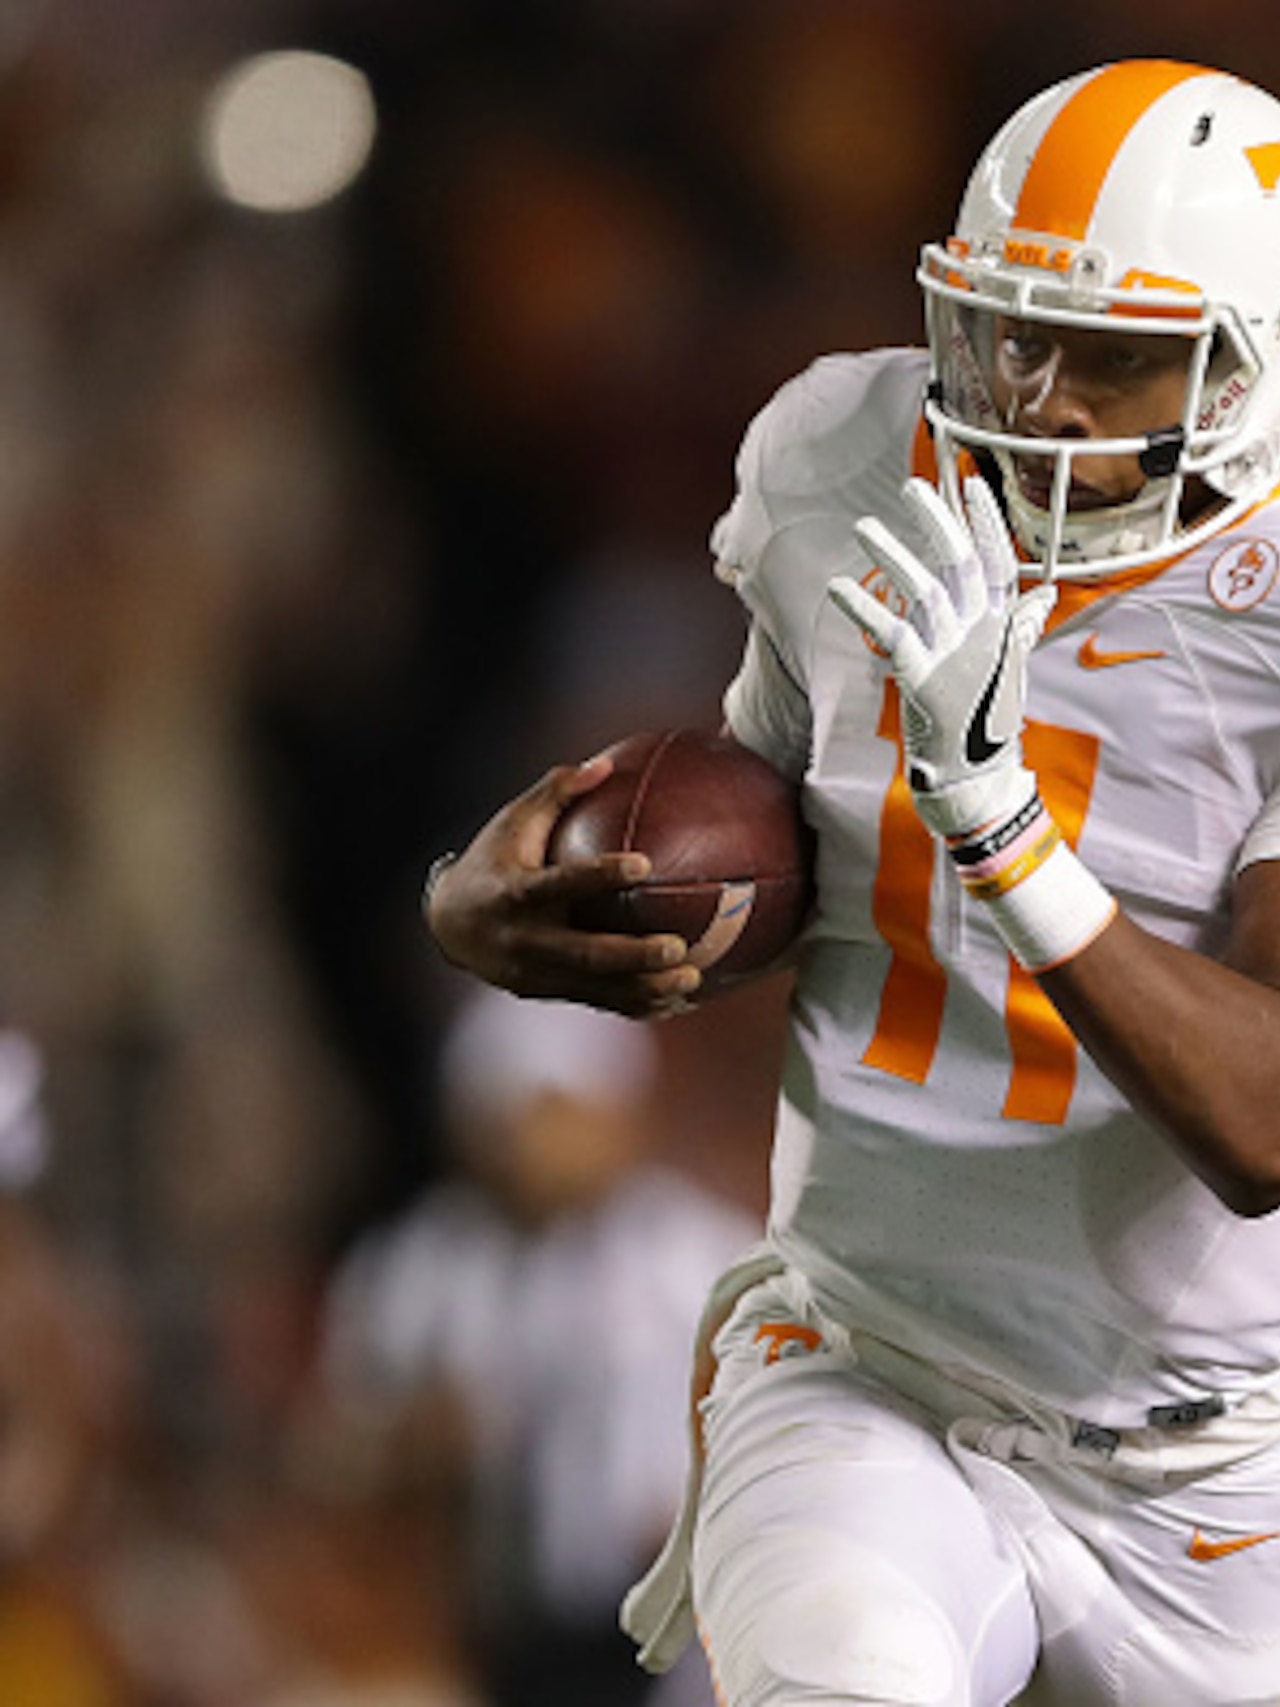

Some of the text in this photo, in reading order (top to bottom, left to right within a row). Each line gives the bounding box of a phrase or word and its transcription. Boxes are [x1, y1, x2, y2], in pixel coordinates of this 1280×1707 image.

[1004, 240, 1070, 273] VOLS
[860, 675, 1100, 1126] 11
[753, 1322, 823, 1366] T
